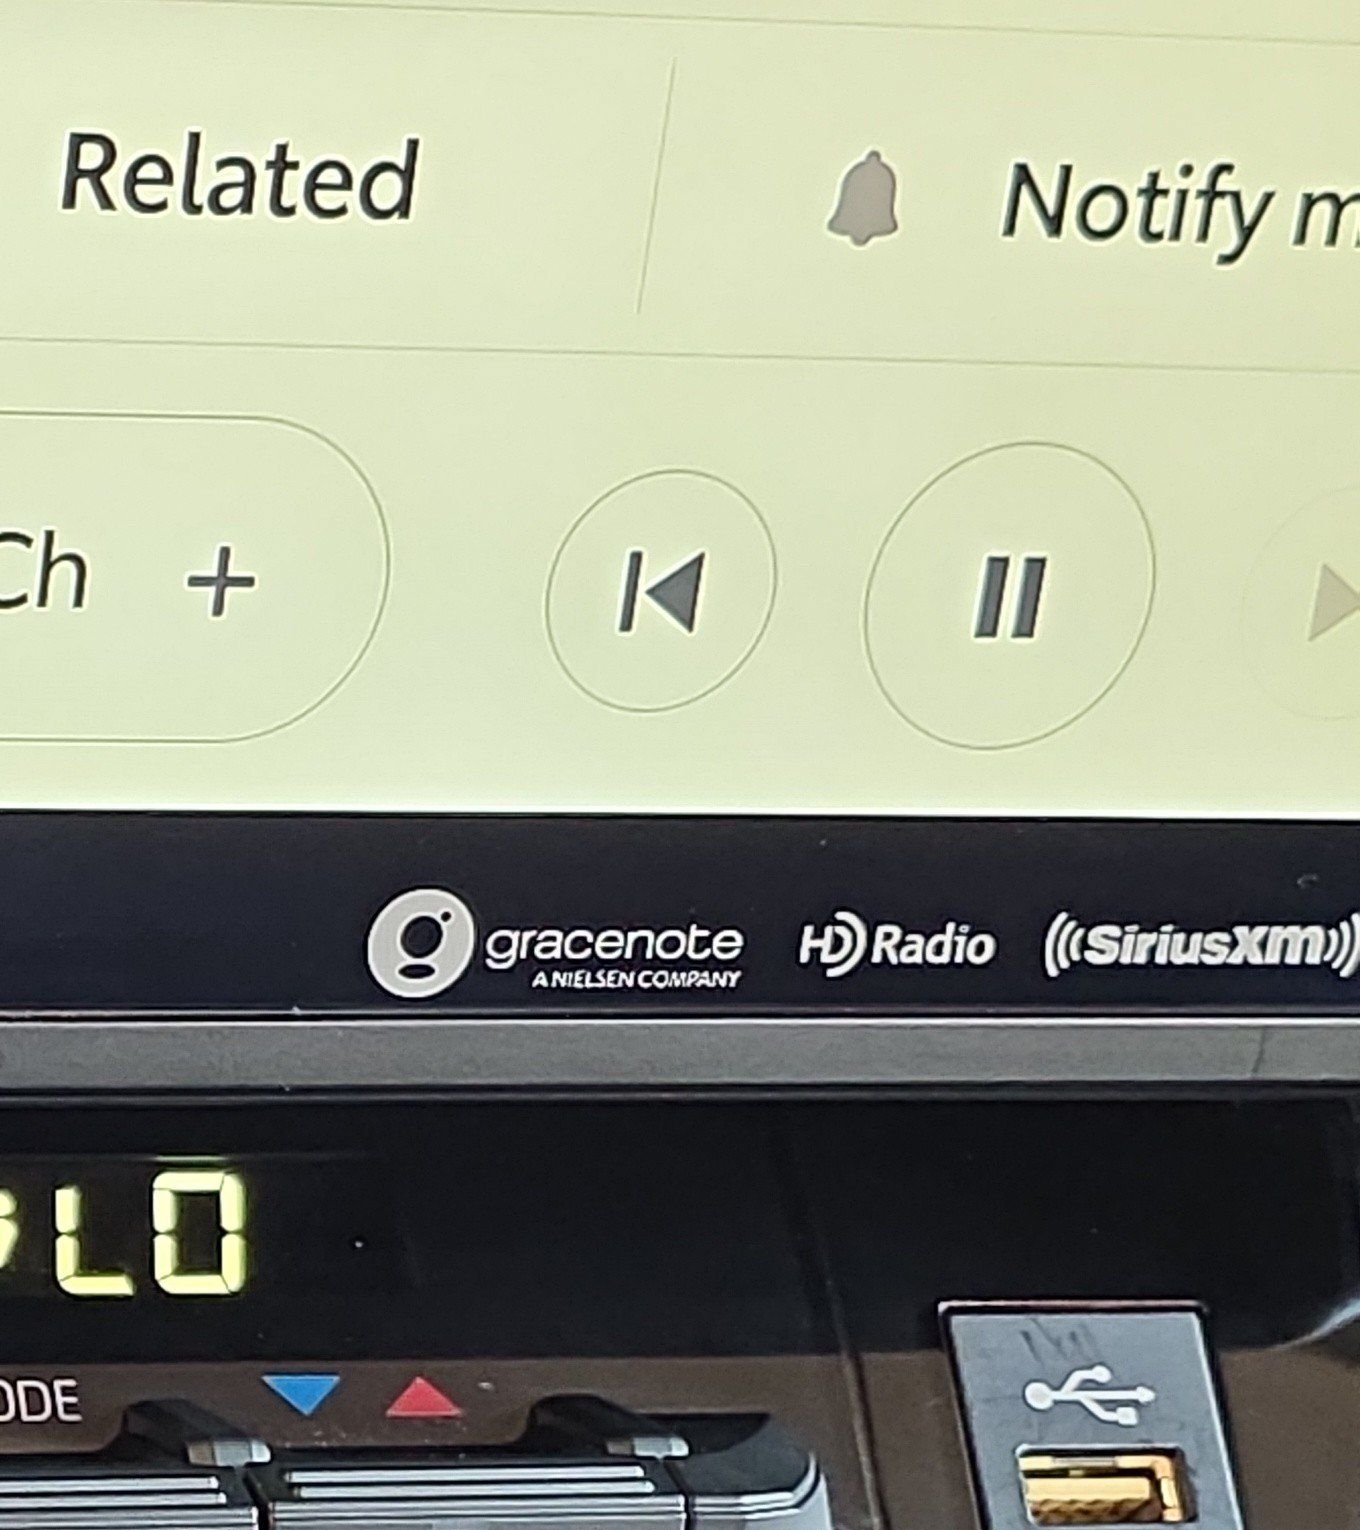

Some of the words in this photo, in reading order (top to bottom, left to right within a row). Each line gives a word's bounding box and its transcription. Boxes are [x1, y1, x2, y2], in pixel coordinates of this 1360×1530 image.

[62, 132, 419, 220] Related
[1002, 163, 1276, 265] Notify
[486, 923, 744, 969] gracenote
[871, 921, 997, 965] Radio
[532, 971, 549, 988] A
[551, 970, 634, 989] NIELSEN
[637, 969, 743, 989] COMPANY
